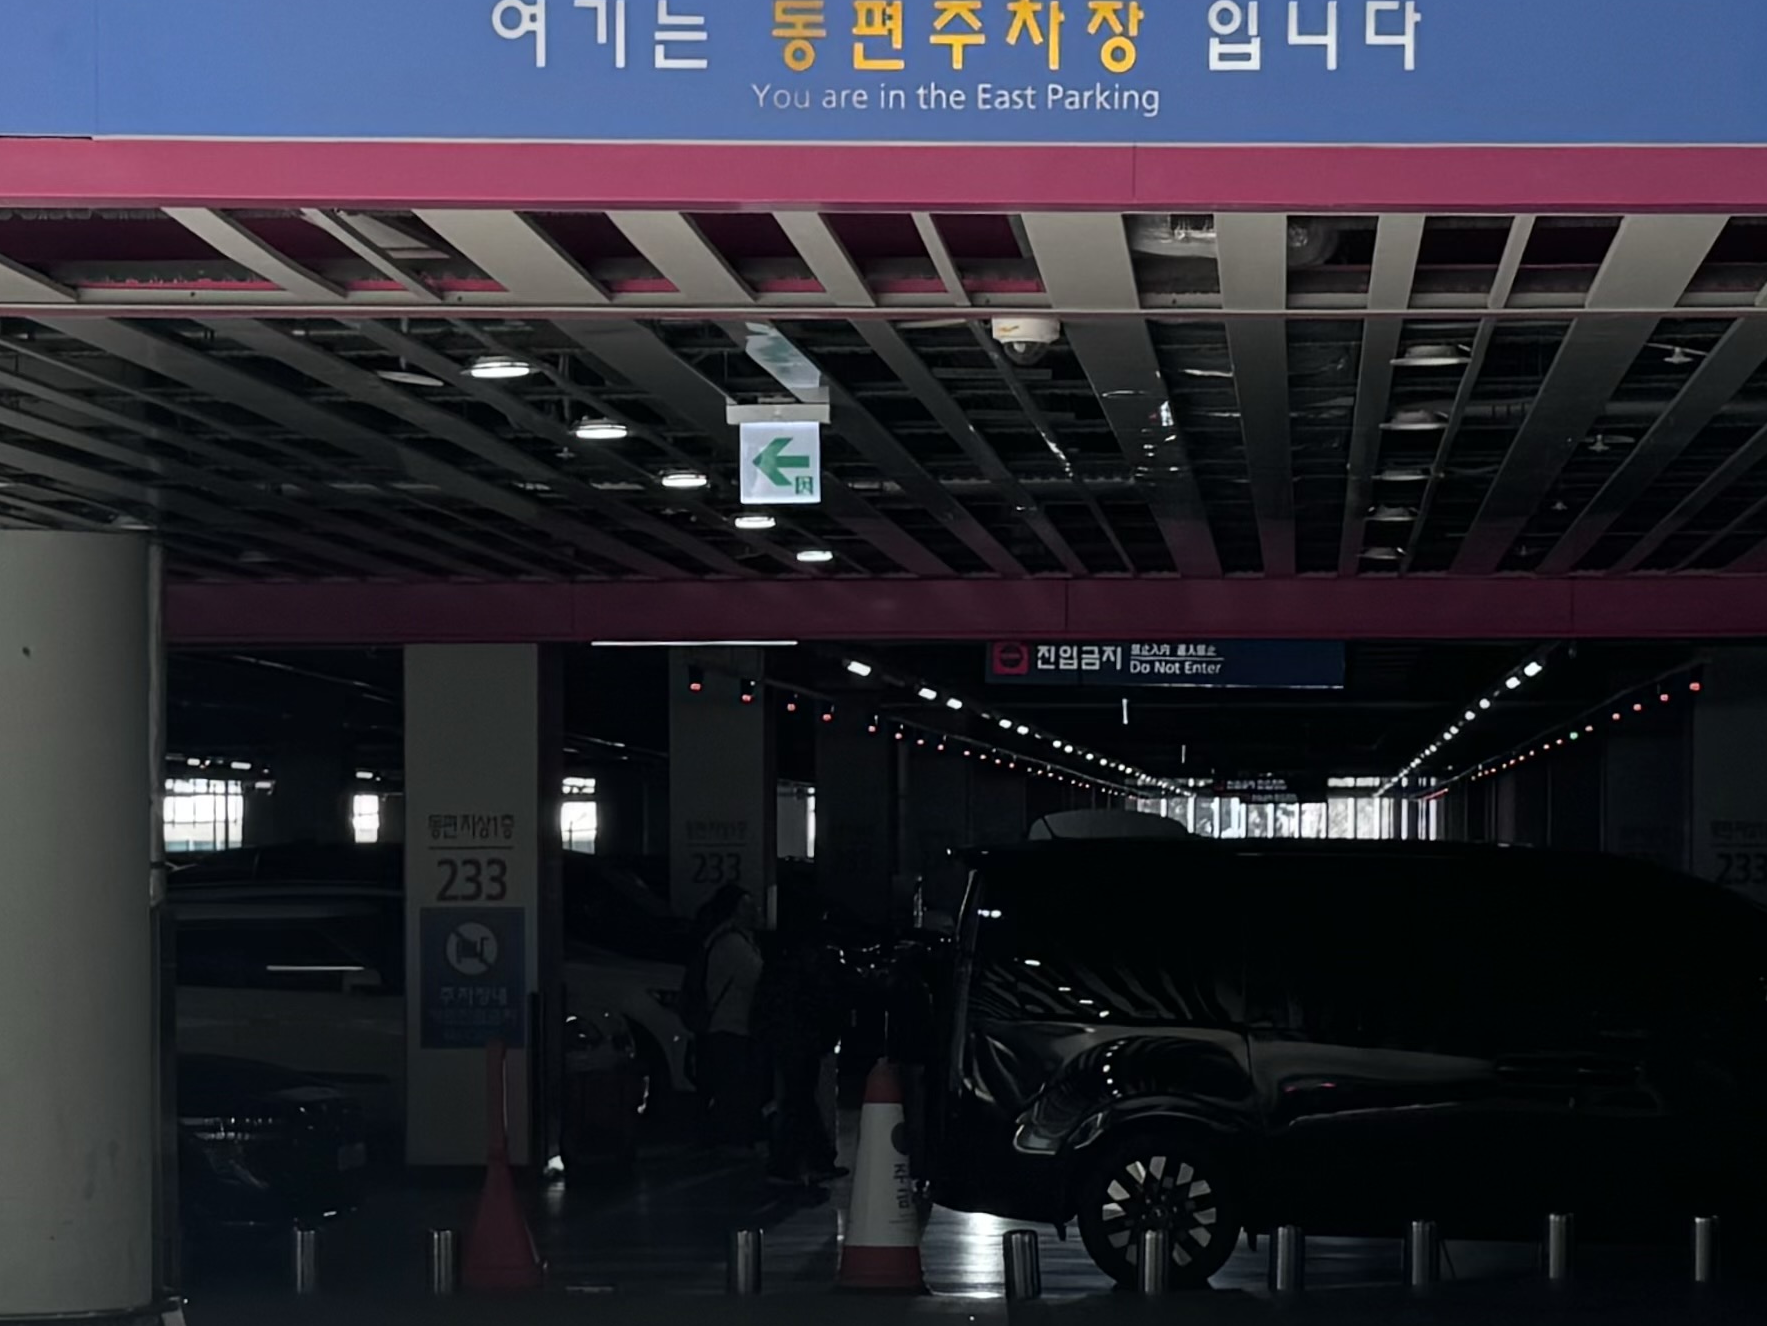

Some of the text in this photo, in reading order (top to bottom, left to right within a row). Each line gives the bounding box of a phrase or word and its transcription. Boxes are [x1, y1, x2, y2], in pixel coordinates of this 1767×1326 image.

[751, 83, 1161, 117] You are in the East Parking
[1035, 644, 1124, 672] 진입금지
[1129, 660, 1222, 675] Do Not Enter
[436, 857, 508, 903] 233
[691, 852, 742, 884] 233
